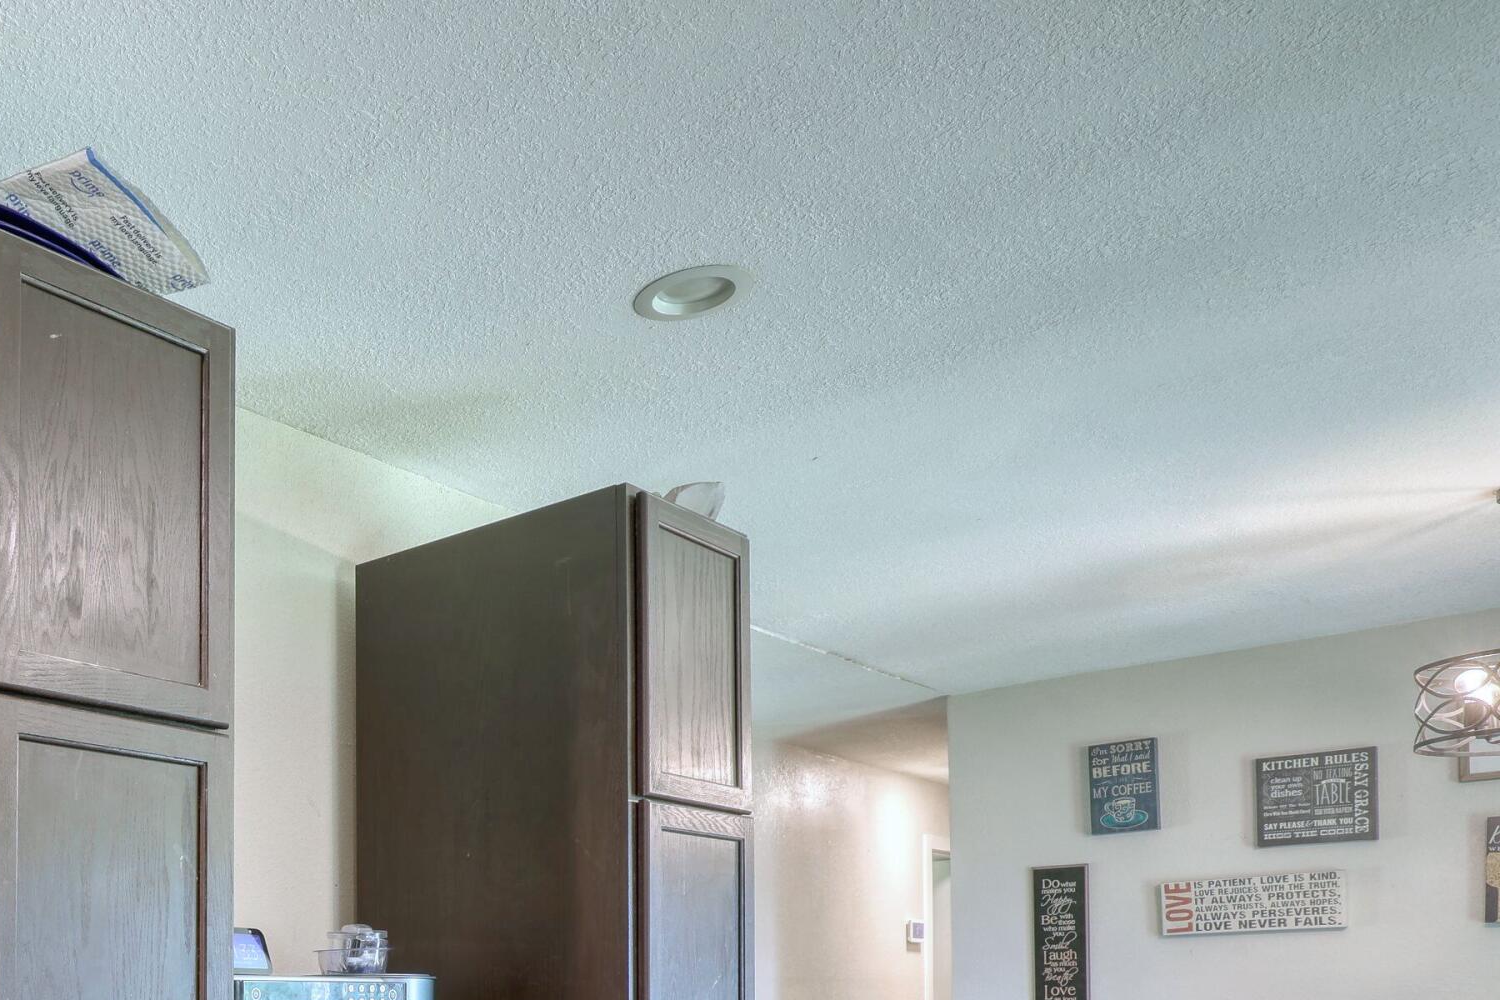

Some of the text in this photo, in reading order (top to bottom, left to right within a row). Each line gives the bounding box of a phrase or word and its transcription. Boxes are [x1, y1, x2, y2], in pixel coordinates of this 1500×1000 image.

[69, 170, 105, 198] prime
[110, 216, 120, 228] my
[120, 225, 133, 238] love
[120, 215, 137, 230] Fast
[132, 227, 157, 252] delivery
[89, 240, 121, 268] prime
[1110, 740, 1151, 754] SORRY
[1092, 757, 1109, 766] for
[1262, 751, 1369, 771] KITCHEN RULES
[1092, 761, 1152, 778] BEFORE
[1092, 782, 1153, 799] MY COFFEE
[1270, 788, 1303, 799] dishes
[1314, 781, 1352, 805] TABLE
[1353, 763, 1370, 834] SAY GRACE
[1264, 823, 1277, 831] SAY
[1279, 820, 1305, 829] PLEASE
[1313, 818, 1337, 827] THANK
[1338, 817, 1354, 825] YOU
[1194, 871, 1340, 889] IS PATIENT, LOVE IS KIND.
[1194, 889, 1215, 897] LOVE
[1218, 886, 1258, 895] REJOICES
[1289, 883, 1304, 891] THE
[1309, 881, 1340, 890] TRUTH.
[1194, 889, 1341, 905] IT ALWAYS PROTECTS,
[1164, 881, 1194, 934] LOVE
[1271, 900, 1306, 908] ALWAYS
[1310, 898, 1342, 906] HOPES,
[1041, 915, 1058, 925] Be
[1195, 906, 1342, 922] ALWAYS PERSEVERES.
[1195, 916, 1342, 932] LOVE NEVER FAILS.
[1043, 949, 1077, 965] Laugh
[1044, 984, 1077, 1000] Love
